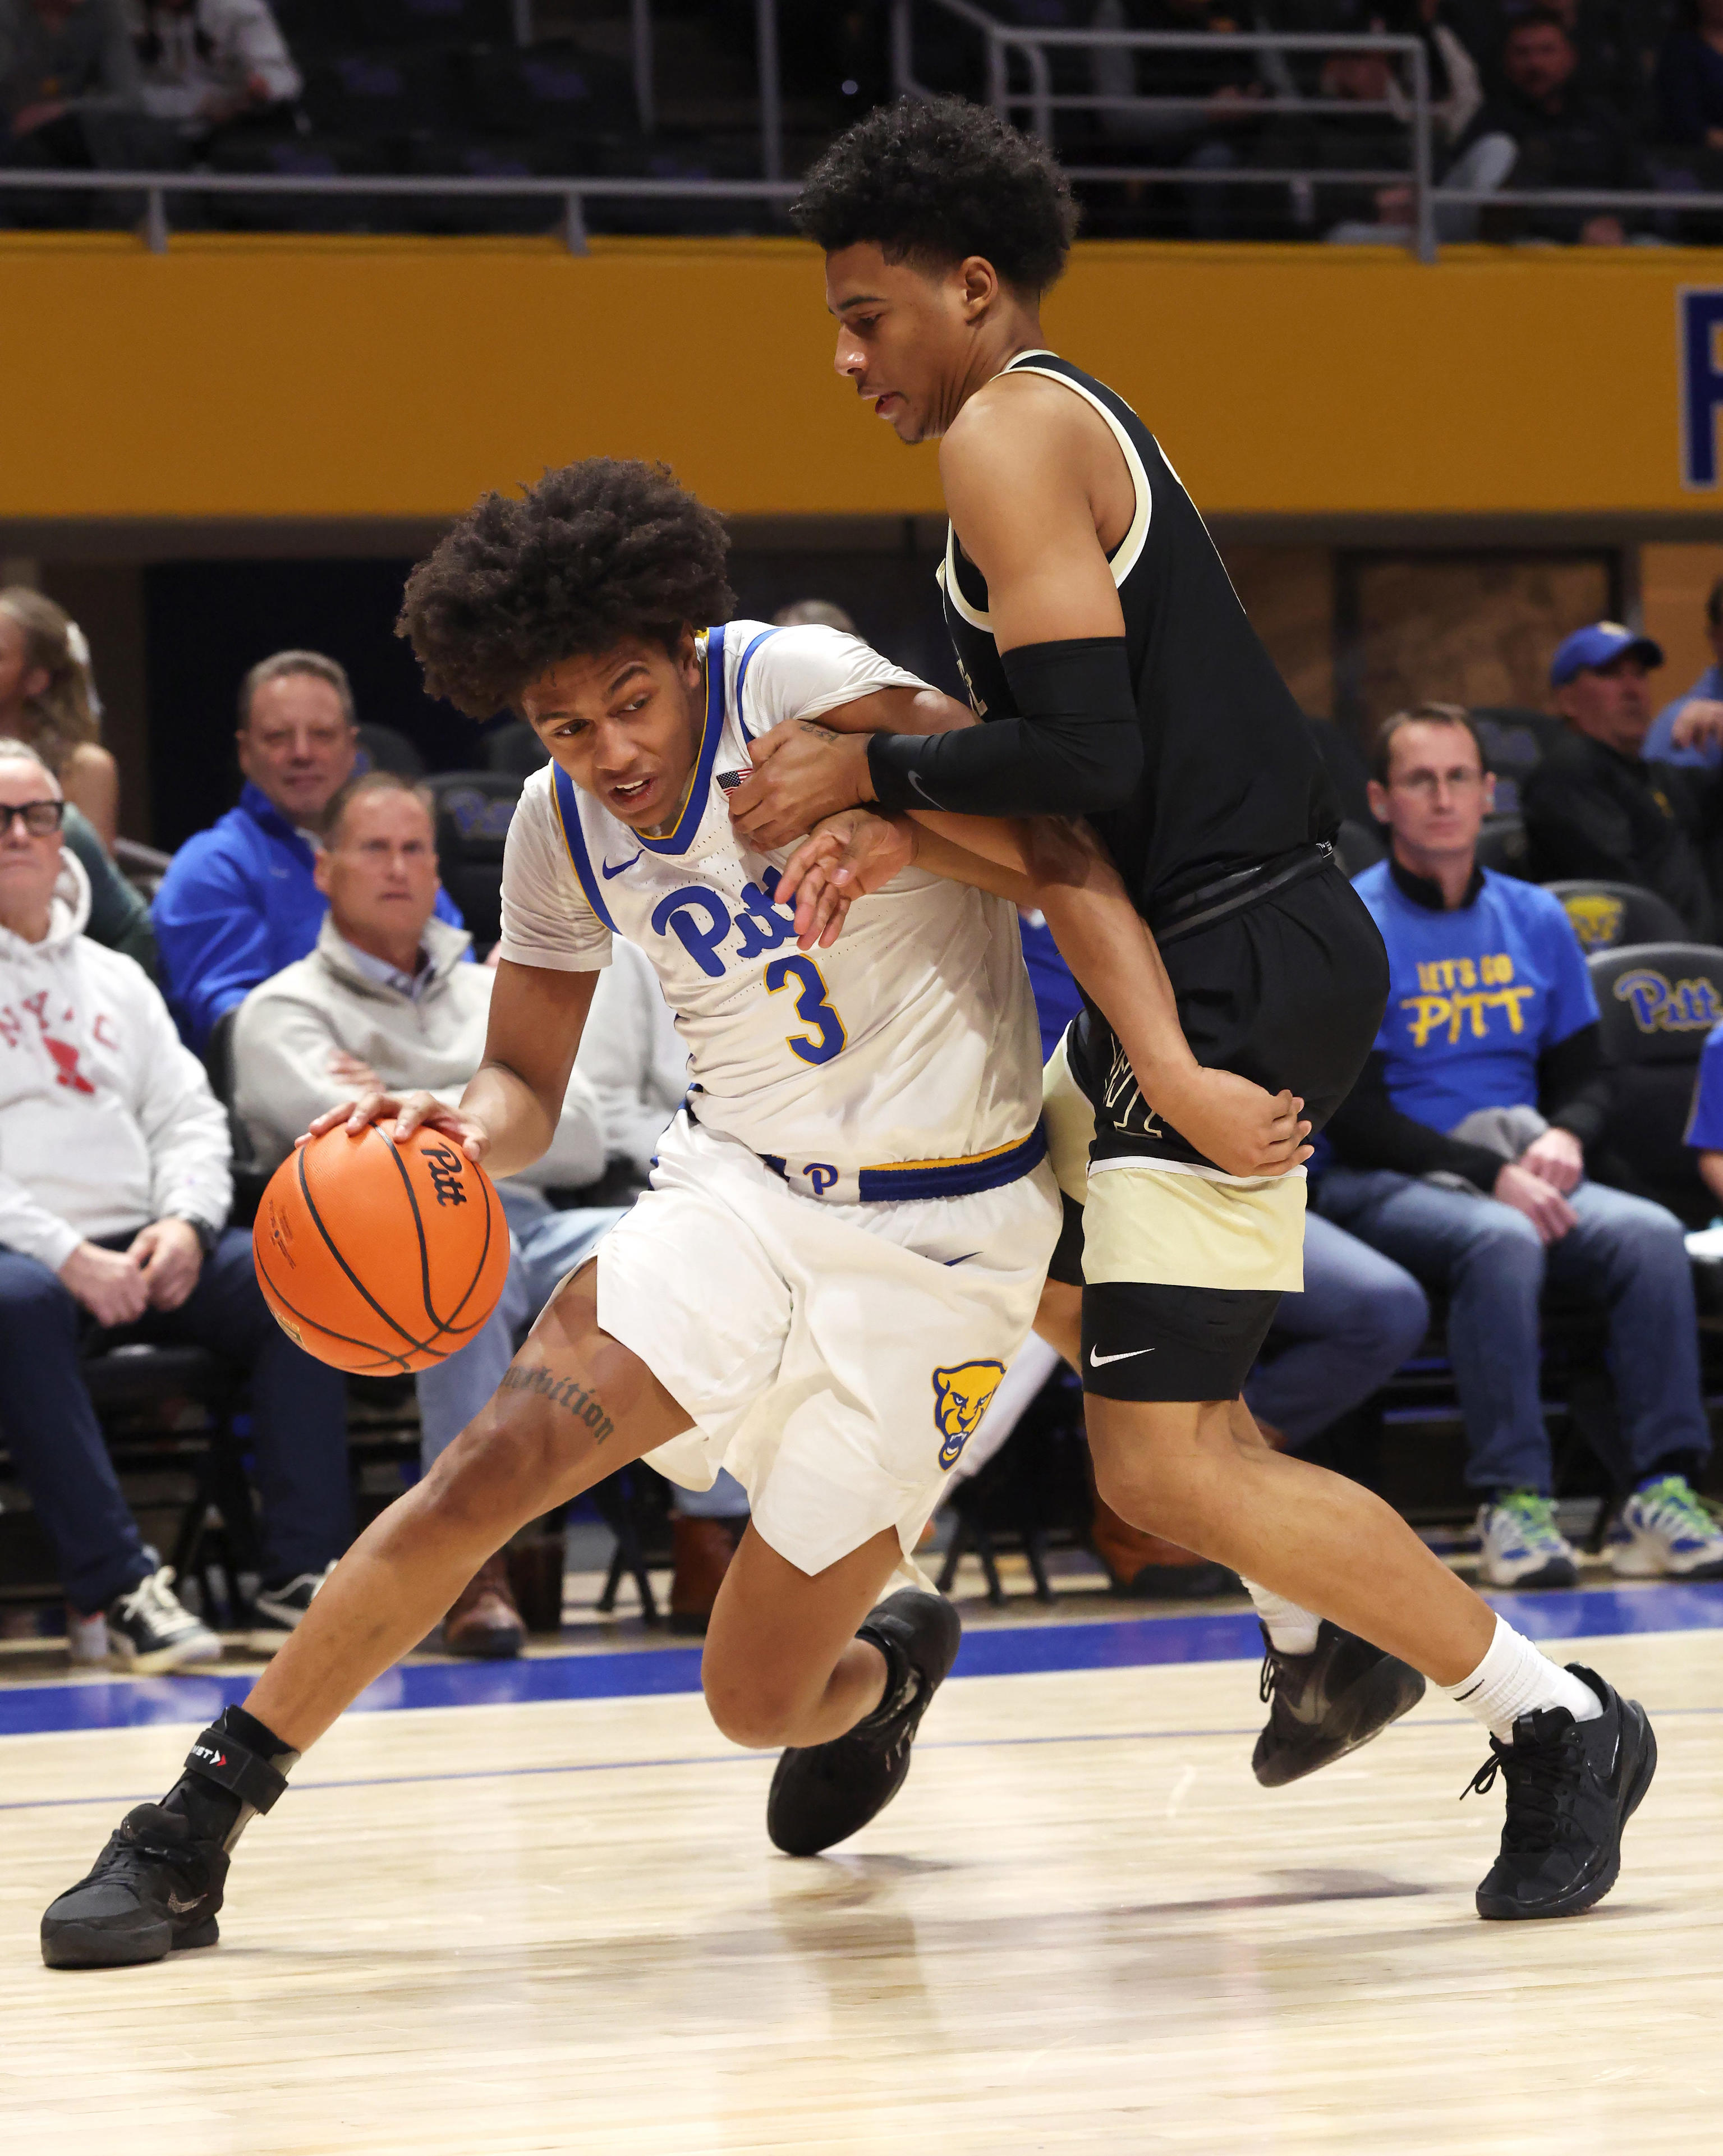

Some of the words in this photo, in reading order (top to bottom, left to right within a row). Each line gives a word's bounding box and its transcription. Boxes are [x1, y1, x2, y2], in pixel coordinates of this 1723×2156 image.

[764, 953, 848, 1066] 3
[1399, 986, 1535, 1048] PITT
[1614, 969, 1723, 1034] Pitt
[421, 1142, 467, 1207] Pitt
